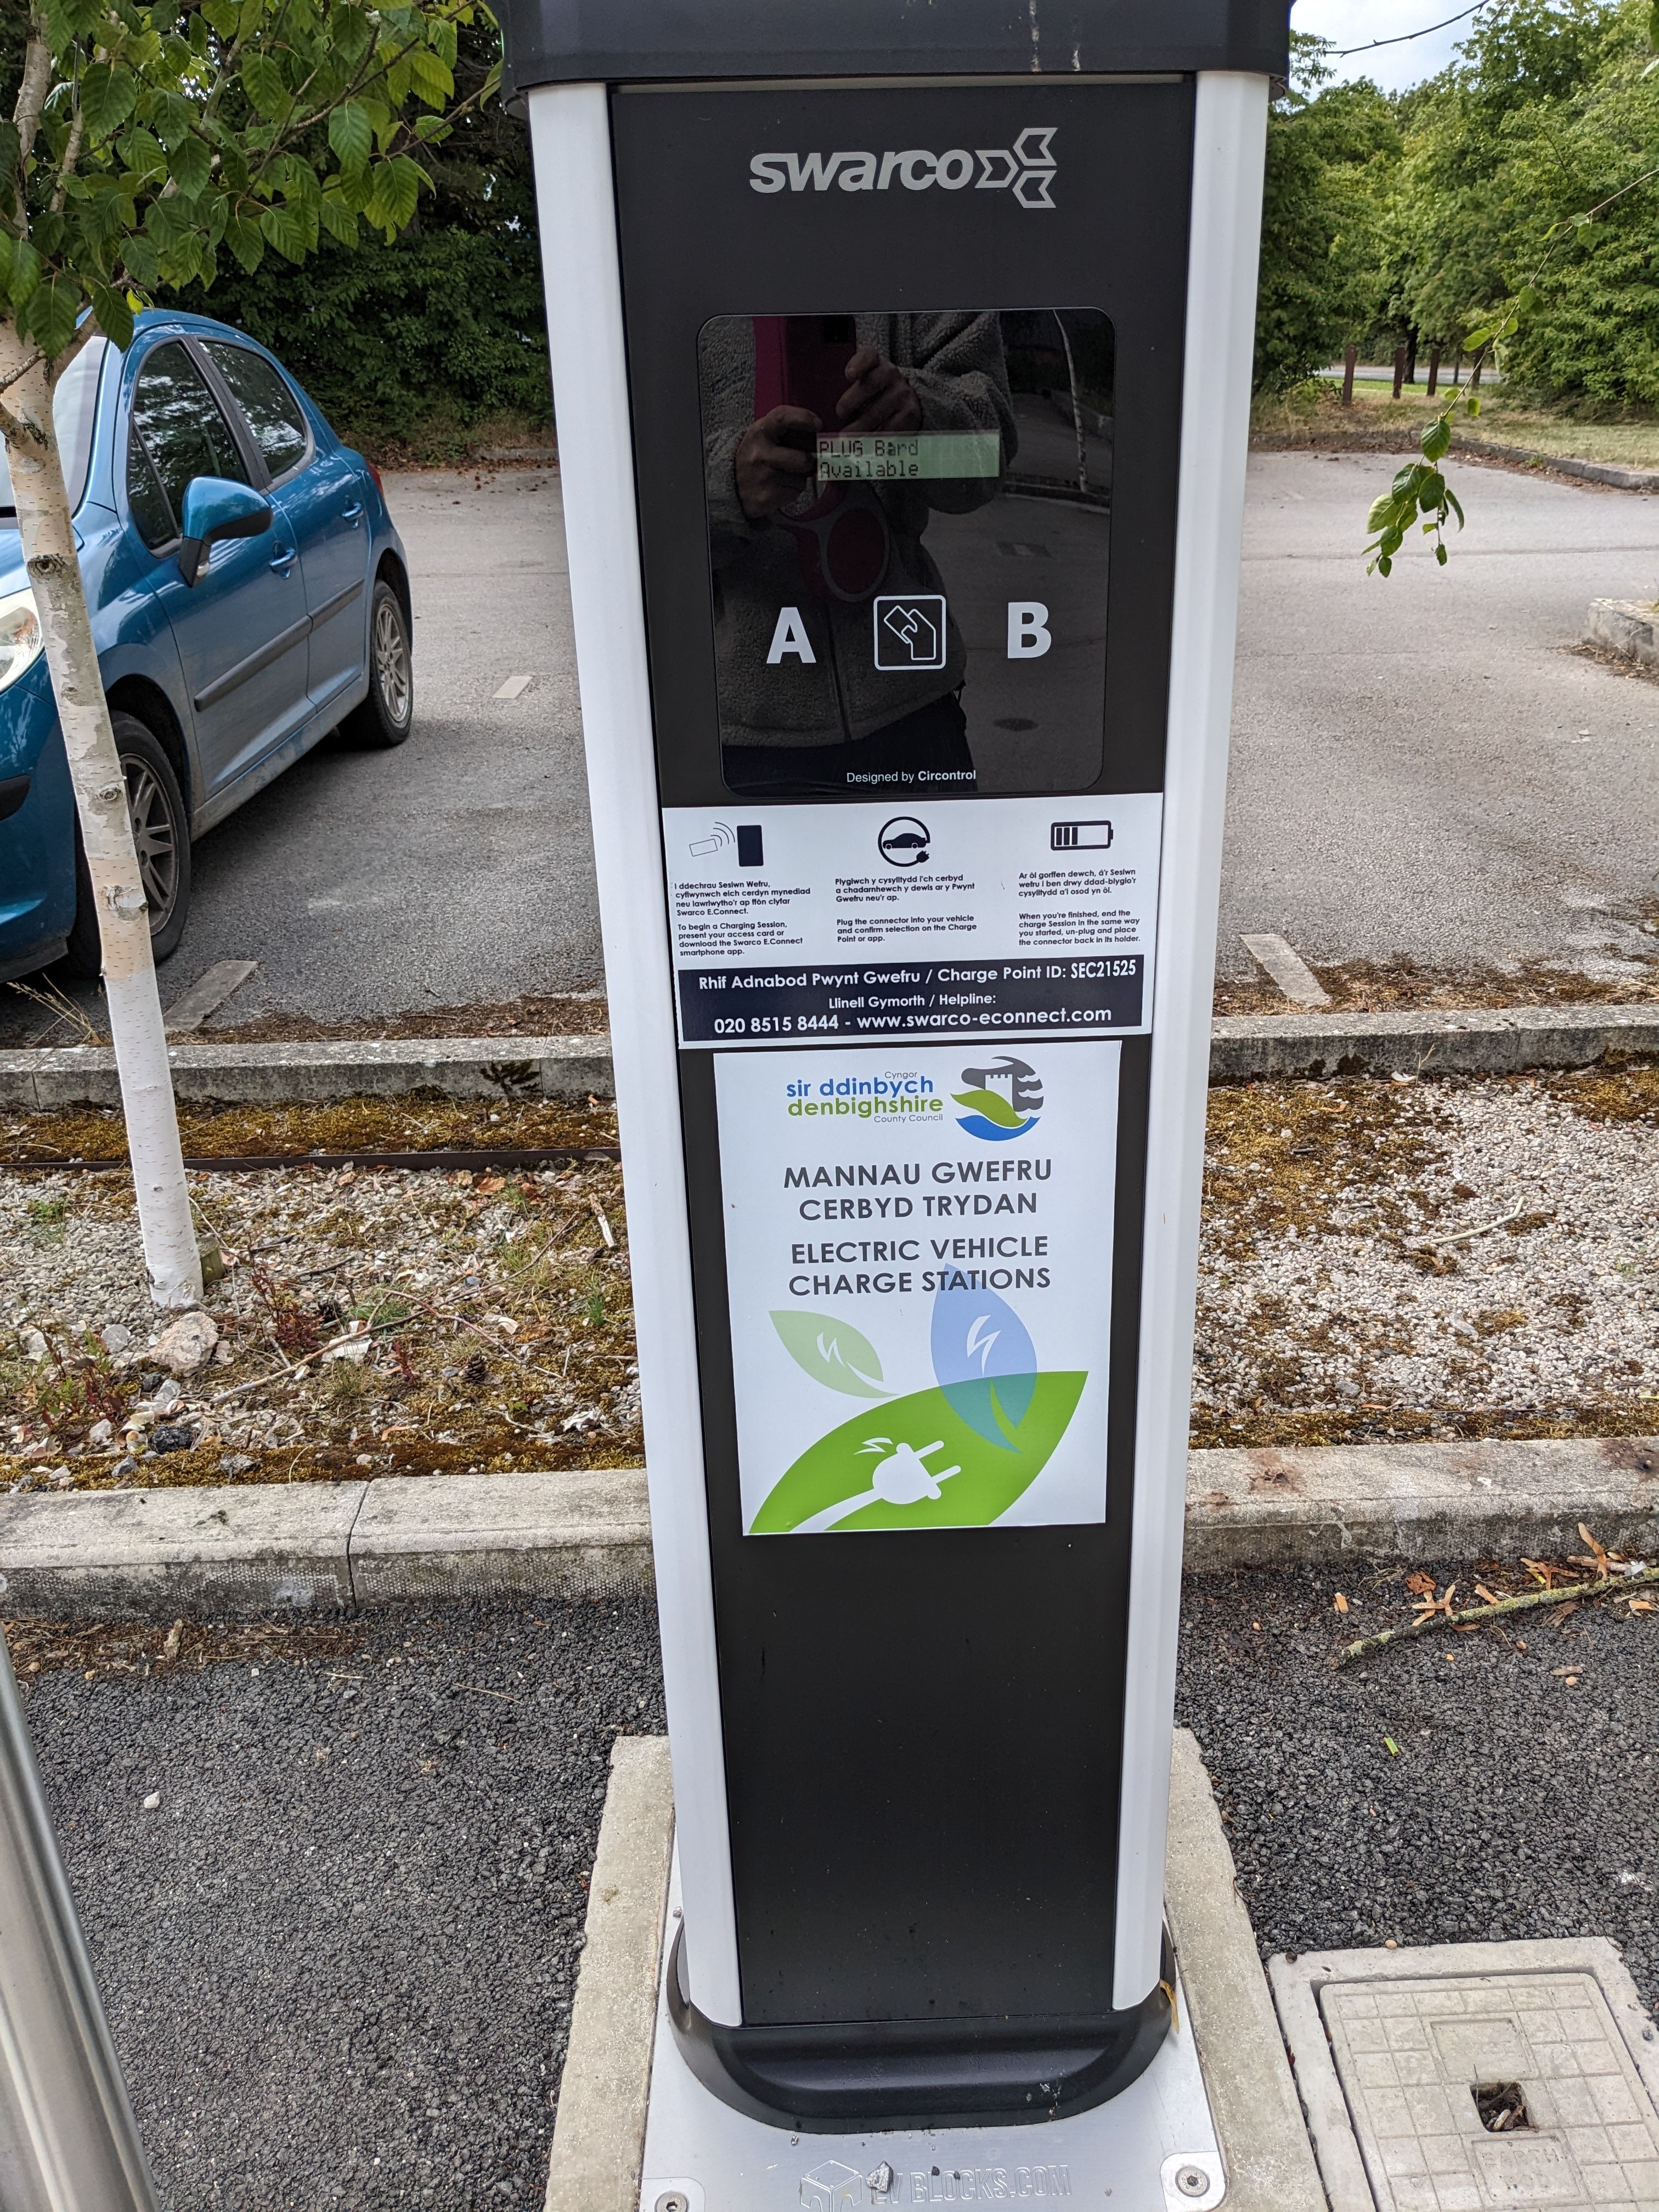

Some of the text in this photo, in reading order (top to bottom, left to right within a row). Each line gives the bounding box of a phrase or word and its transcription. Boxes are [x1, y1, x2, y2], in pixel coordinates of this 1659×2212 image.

[749, 149, 974, 193] swarco
[820, 441, 863, 458] PLUG
[820, 460, 918, 478] Available
[766, 607, 816, 664] A
[1008, 602, 1051, 658] B
[847, 770, 976, 784] Designed by Circontrol
[835, 877, 870, 886] Plygiwch
[878, 876, 917, 885] cysylltydd
[935, 874, 963, 883] cerbyd
[1039, 871, 1065, 880] gorffen
[1084, 877, 1136, 885] ddad-blygio'r
[675, 890, 721, 899] cyflwynwch
[771, 888, 810, 896] mynediad
[843, 885, 902, 893] chadarnhewch
[952, 883, 975, 891] Pwynt
[1018, 889, 1057, 898] cysylltydd
[692, 899, 737, 907] lawrlwytho'r
[769, 898, 790, 906] clyfar
[1042, 912, 1066, 921] you're
[720, 922, 755, 930] Charging
[1066, 928, 1095, 936] un-plug
[679, 932, 707, 940] present
[699, 959, 1136, 989] Rhif Adnabod Pwynt Gwefru / Charge Point ID: SEC21525
[829, 993, 996, 1009] Llinell Gymorth / Helpline:
[714, 1018, 745, 1033] 020
[751, 1017, 792, 1032] 8515
[798, 1014, 838, 1030] 8444
[857, 1008, 1111, 1028] www.swarco-econnect.com
[884, 1071, 917, 1080] Cyngor
[786, 1075, 934, 1098] sir ddinbych
[788, 1095, 943, 1118] denbighshire
[874, 1115, 906, 1124] County
[784, 1159, 1051, 1188] MANNAU GWEFRU
[799, 1193, 1036, 1221] CERBYD TRYDAN
[792, 1236, 1047, 1264] ELECTRIC VEHICLE
[789, 1268, 1050, 1296] CHARGE STATIONS
[910, 2165, 1071, 2202] BLOCKS.COM
